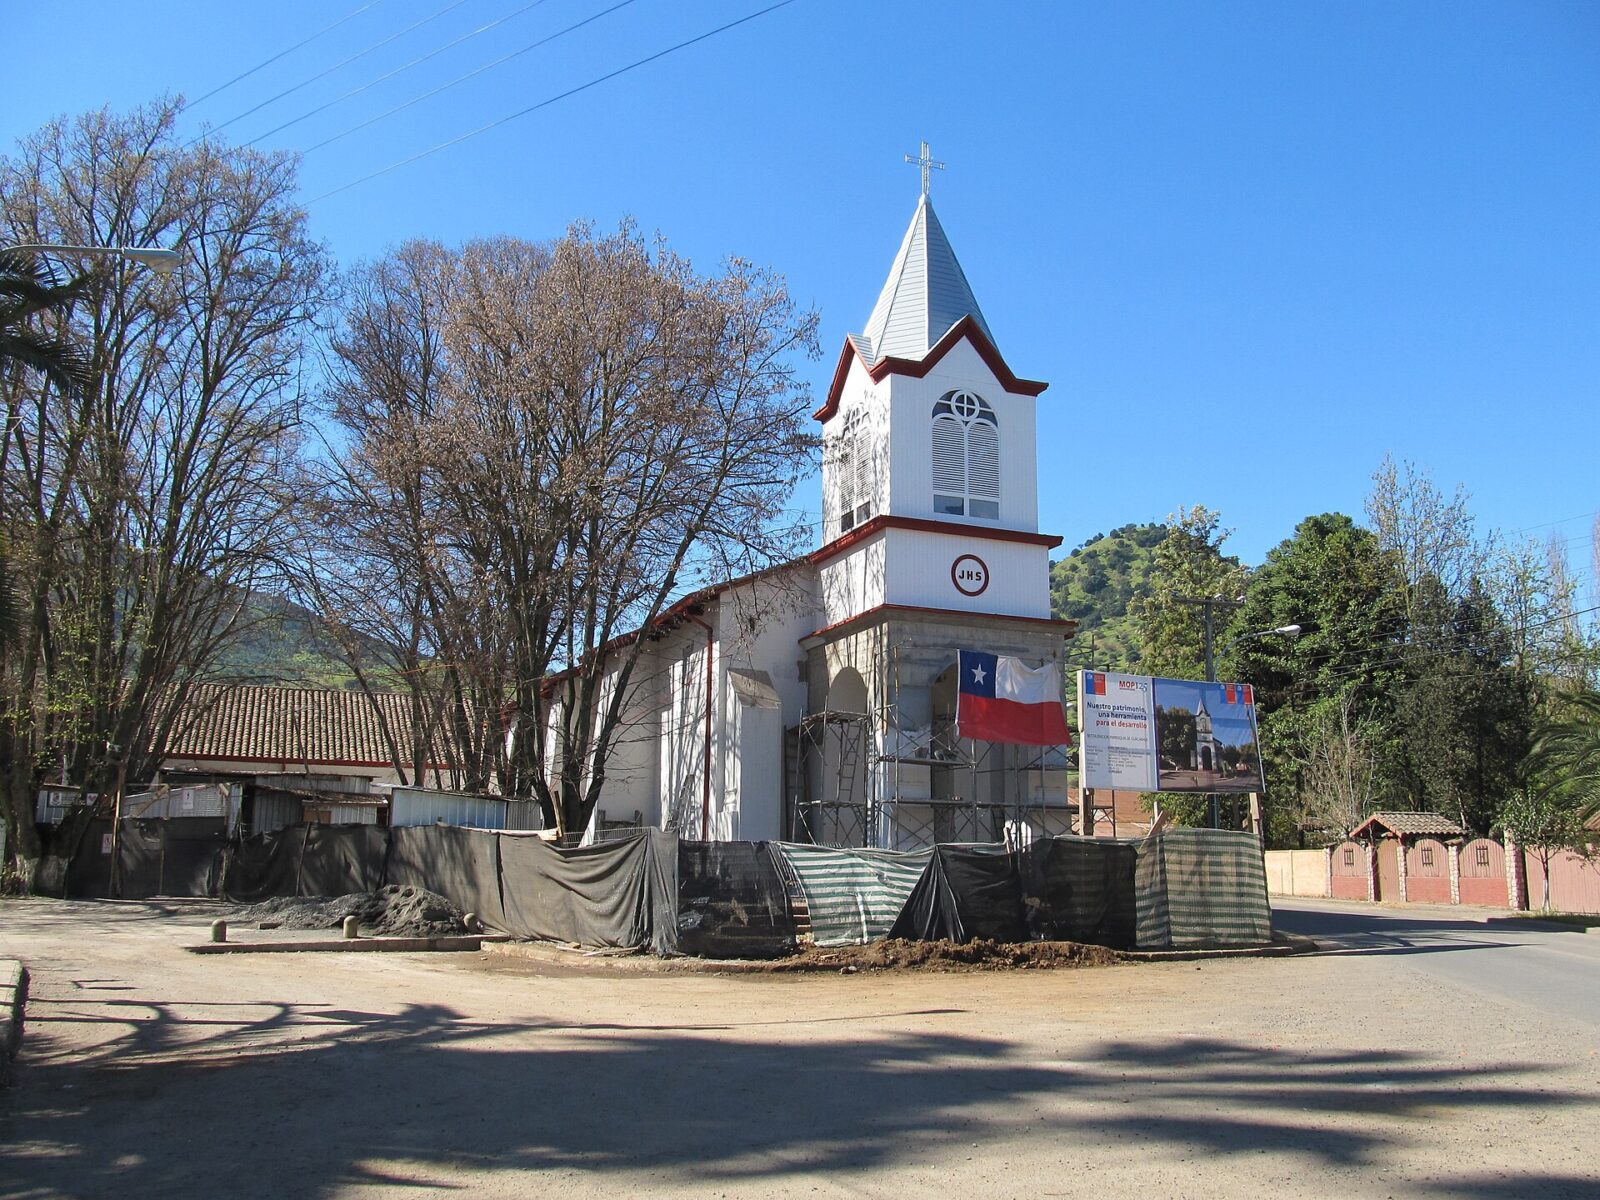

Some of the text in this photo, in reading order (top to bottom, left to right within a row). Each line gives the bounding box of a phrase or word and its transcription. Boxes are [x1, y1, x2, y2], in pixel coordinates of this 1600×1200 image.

[958, 569, 982, 581] JHS
[1087, 701, 1147, 714] Nuestro patrimonio,
[1111, 712, 1147, 721] herramienta
[1118, 721, 1148, 729] desarrollo
